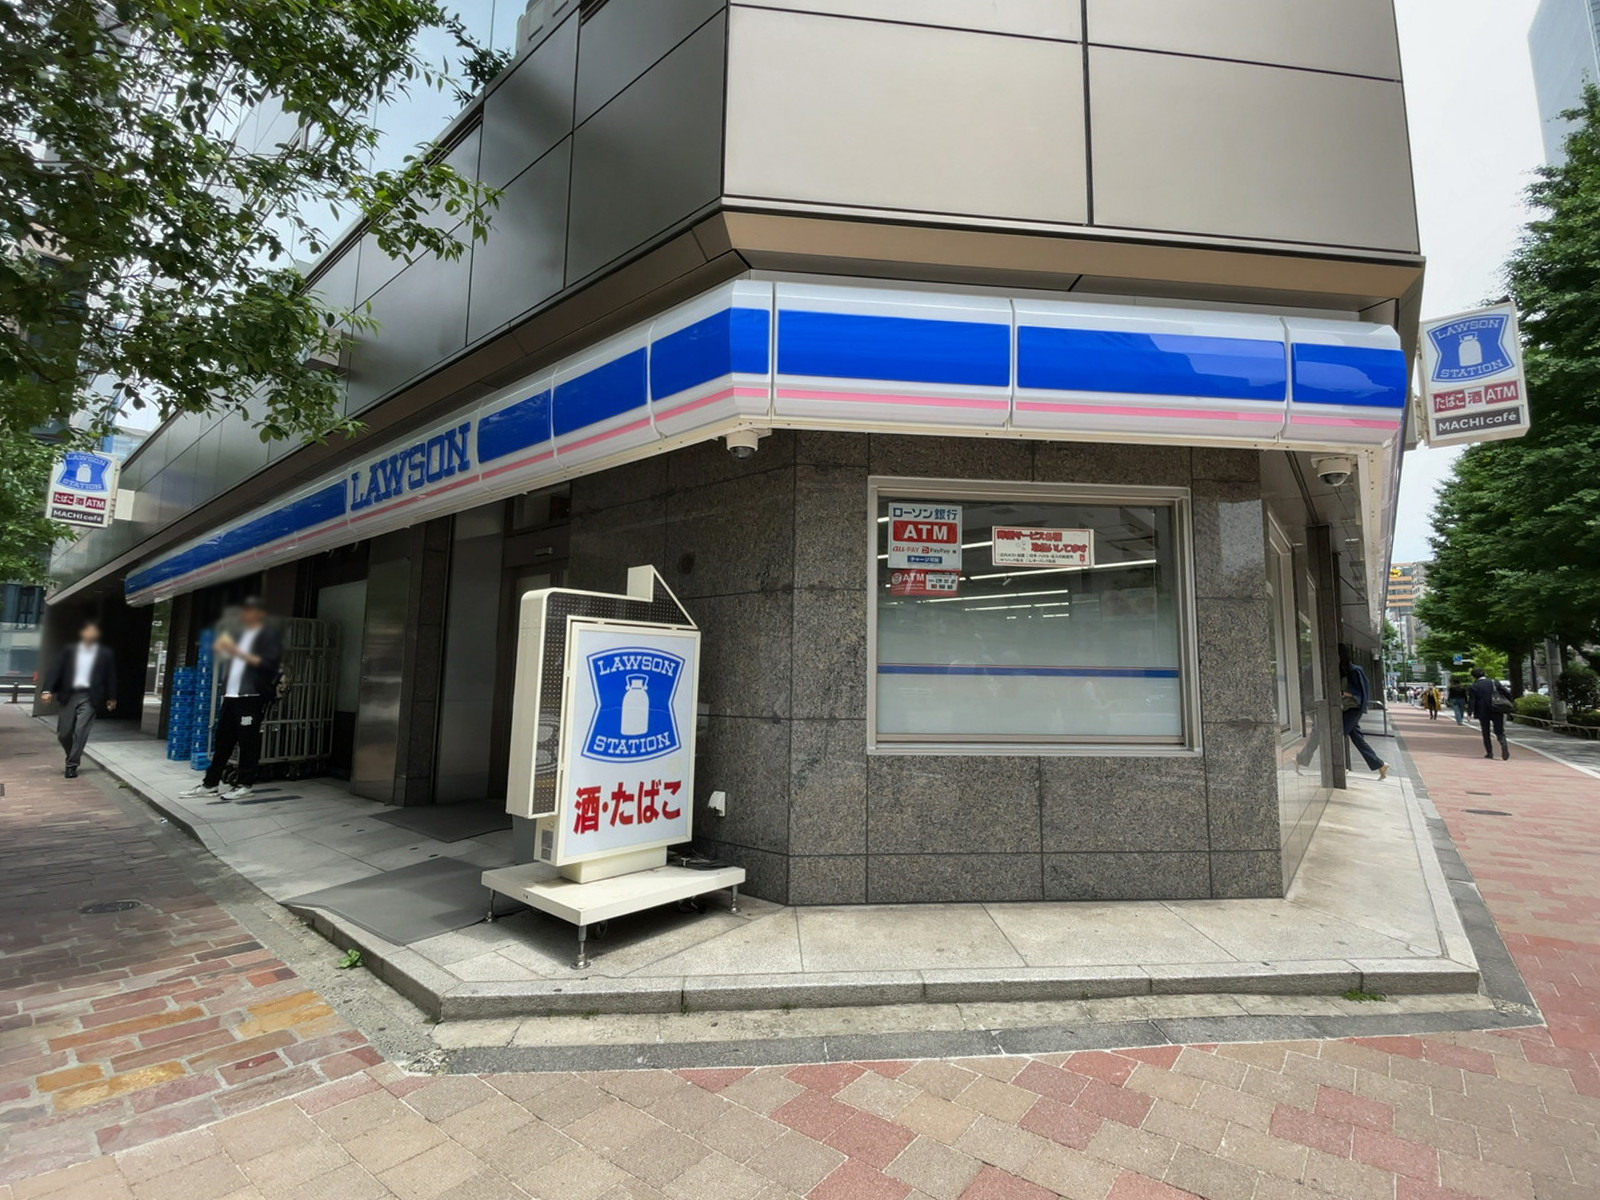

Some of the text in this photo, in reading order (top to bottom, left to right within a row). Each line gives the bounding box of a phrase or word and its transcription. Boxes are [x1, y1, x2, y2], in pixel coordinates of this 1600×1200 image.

[1435, 319, 1500, 340] LAWSON
[1439, 359, 1504, 378] STATION
[1435, 393, 1465, 410] たばこ
[1486, 384, 1516, 401] ATM
[1438, 411, 1517, 432] MACHI café
[66, 453, 107, 467] LAWSON
[350, 421, 471, 511] LAWSON
[62, 478, 102, 490] STATION
[86, 498, 105, 509] ATM
[53, 510, 83, 519] MACHI
[892, 506, 958, 521] ローソン銀行
[902, 523, 948, 541] ATM
[902, 572, 925, 583] ATM
[597, 655, 676, 677] LAWSON
[593, 731, 671, 754] STATION
